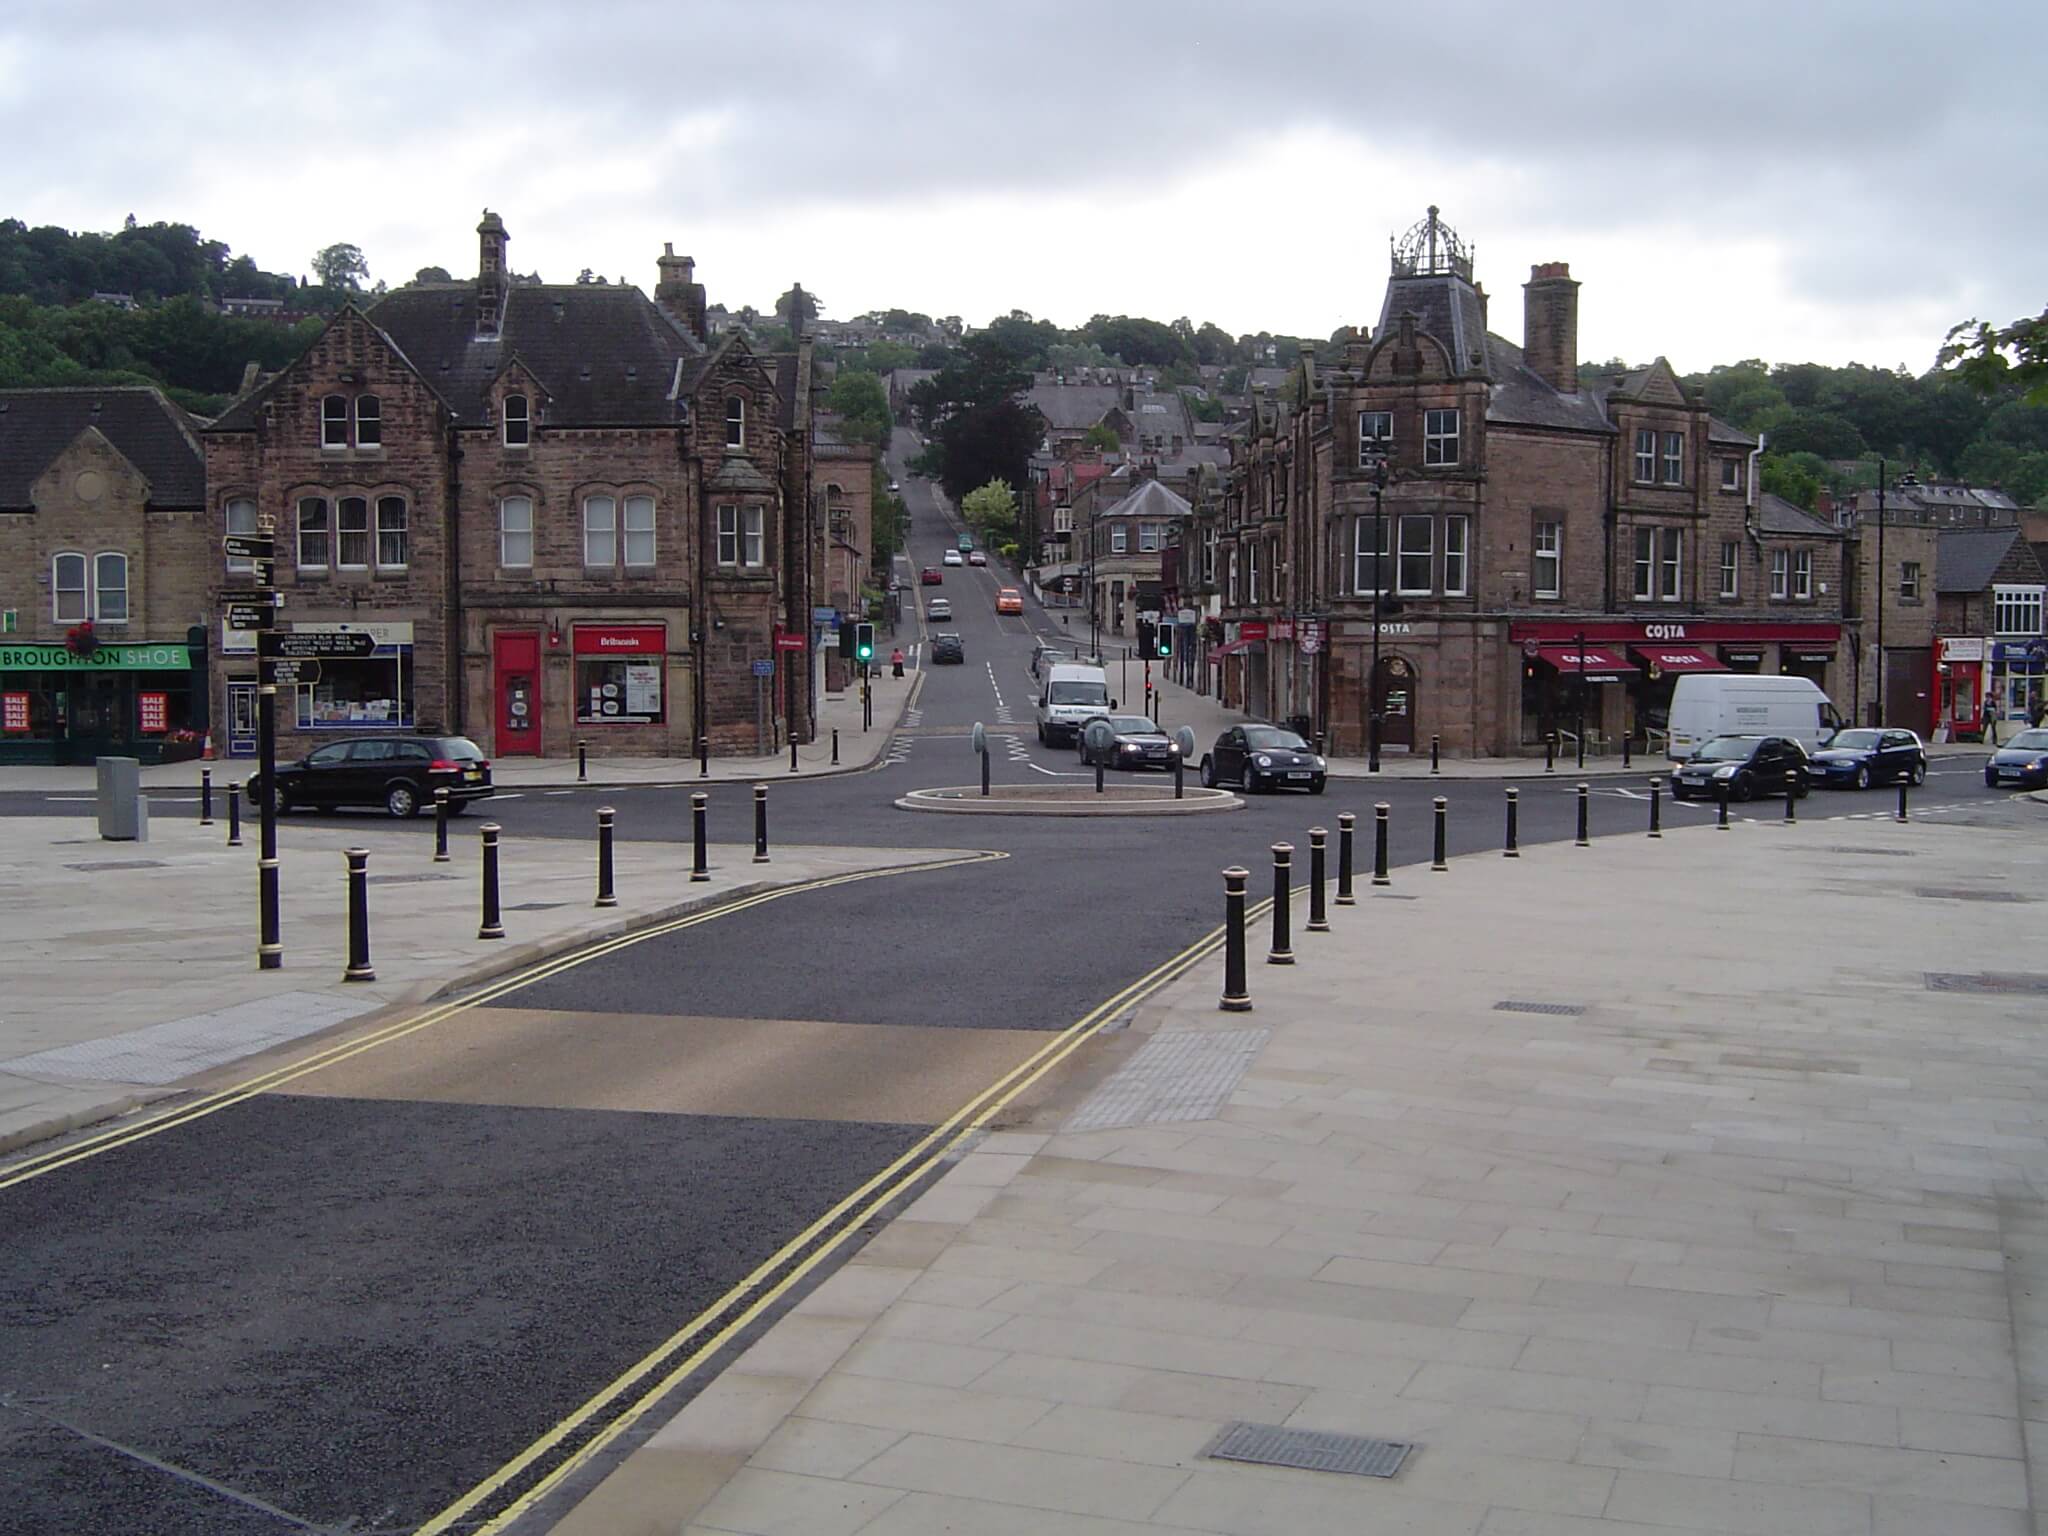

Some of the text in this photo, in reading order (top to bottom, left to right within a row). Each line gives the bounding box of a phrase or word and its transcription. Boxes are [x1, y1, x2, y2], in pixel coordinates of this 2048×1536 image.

[1645, 624, 1686, 640] COSTA
[127, 649, 181, 665] SHOE
[1561, 655, 1607, 664] COSTA
[1661, 655, 1703, 664] COSTA
[5, 720, 28, 728] SALE
[142, 720, 165, 728] SALE
